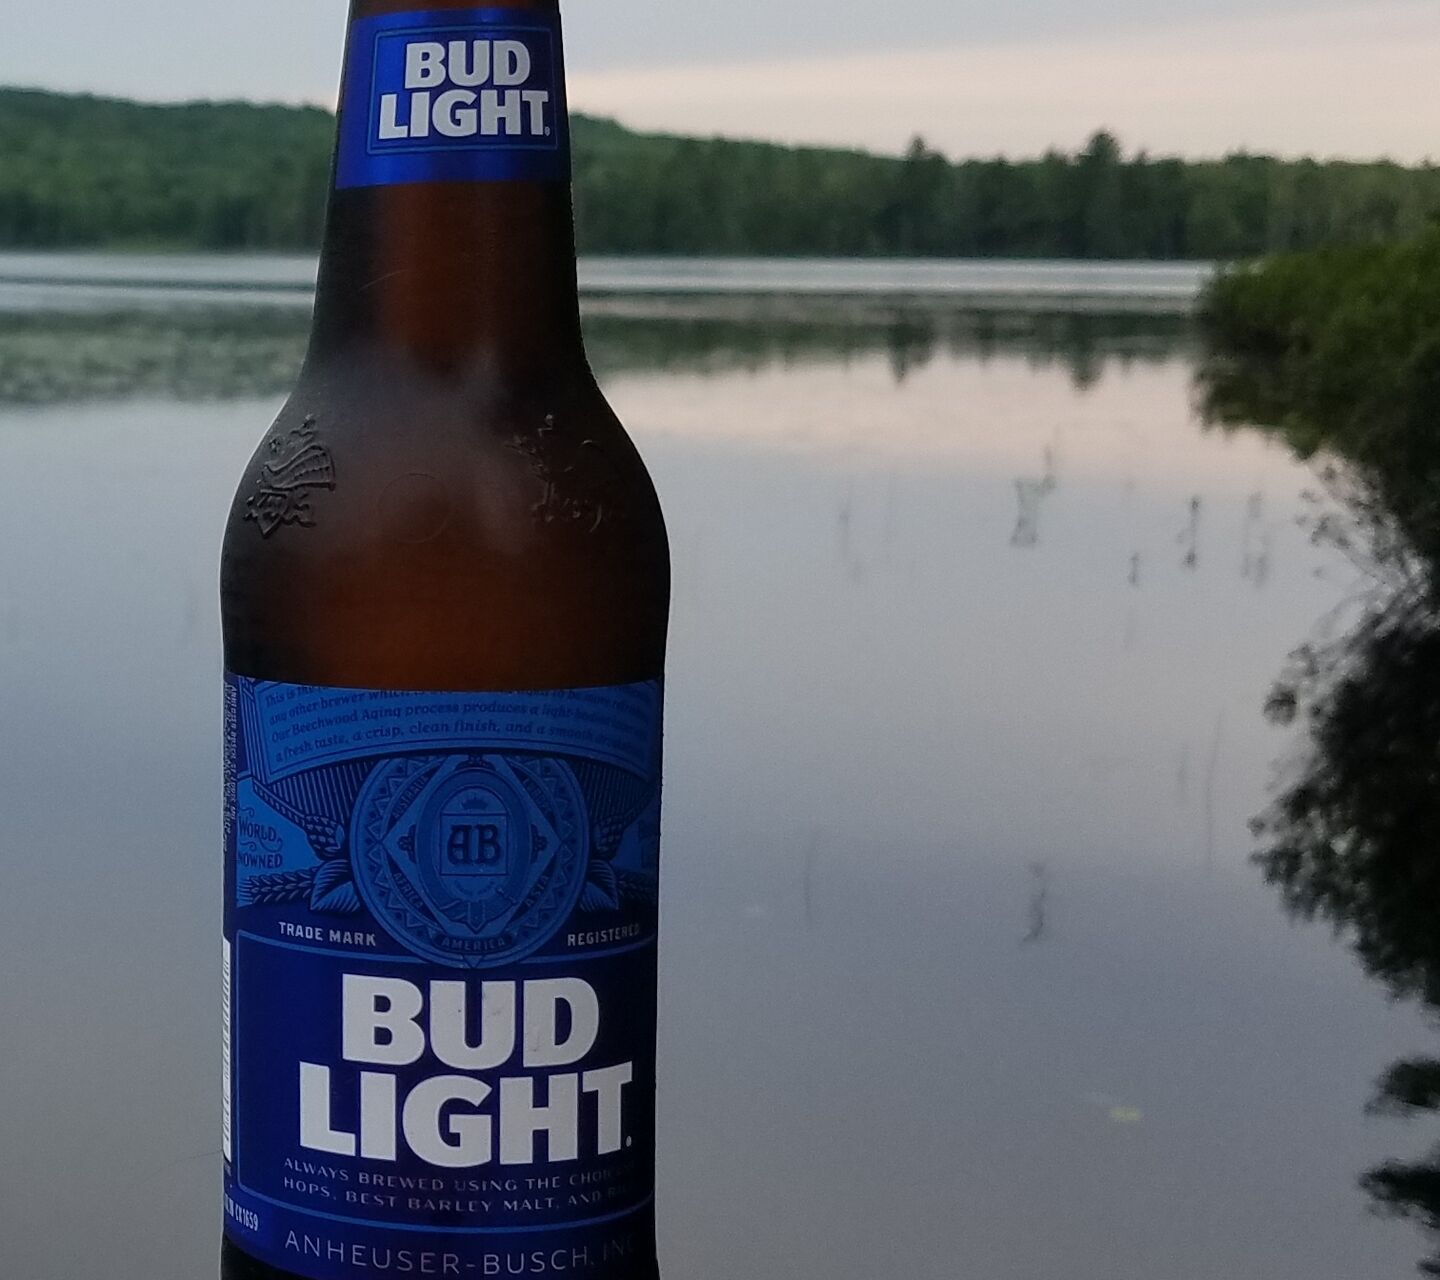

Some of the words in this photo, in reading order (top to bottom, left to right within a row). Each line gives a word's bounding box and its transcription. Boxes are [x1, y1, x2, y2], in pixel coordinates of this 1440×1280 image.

[404, 39, 531, 89] BUD
[378, 89, 549, 139] LIGHT
[293, 710, 358, 736] Beechwood
[363, 707, 400, 721] Aging
[406, 704, 459, 716] process
[464, 701, 527, 715] produces
[409, 720, 449, 734] clean
[505, 720, 532, 733] and
[239, 816, 277, 841] WORLD
[393, 872, 424, 909] AFRICA
[525, 873, 549, 907] ASIA
[278, 922, 323, 941] TRADE
[329, 929, 376, 947] MARK
[442, 936, 505, 951] AMERICA
[567, 923, 640, 947] REGISTERED
[342, 973, 599, 1070] BUD
[299, 1061, 633, 1168] LIGHT
[283, 1157, 350, 1181] ALWAYS
[358, 1171, 444, 1192] BREWED
[454, 1178, 519, 1193] USING
[524, 1175, 561, 1191] THE
[345, 1190, 400, 1208] BEST
[408, 1197, 493, 1213] BARLEY
[567, 1190, 601, 1206] AND
